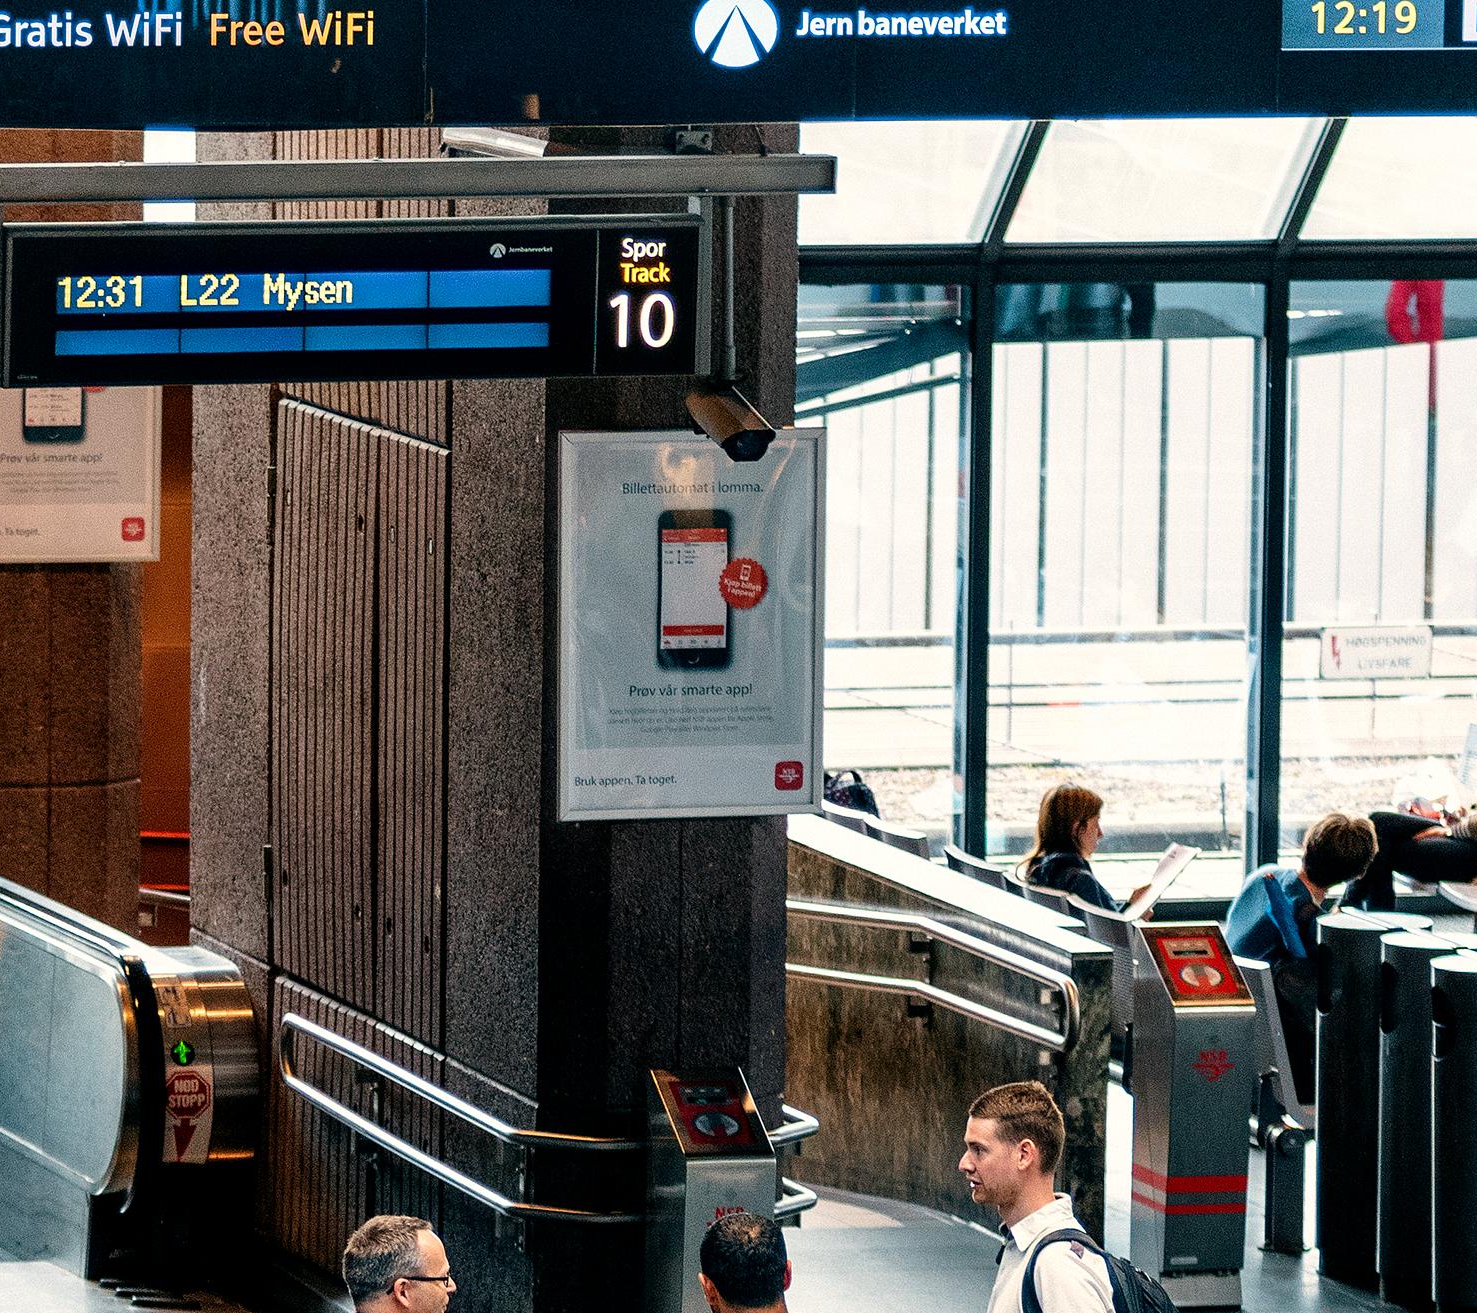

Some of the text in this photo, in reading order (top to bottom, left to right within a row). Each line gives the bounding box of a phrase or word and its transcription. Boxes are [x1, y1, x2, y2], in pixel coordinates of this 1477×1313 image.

[106, 12, 182, 46] WiFi
[211, 11, 373, 45] Free WiFi
[797, 9, 1006, 36] Jernbaneverket
[622, 238, 666, 262] Spor
[621, 260, 670, 283] Track
[57, 273, 353, 311] 12:31 L22 Mysen
[610, 293, 674, 347] 10
[622, 481, 709, 495] Billettautomat
[717, 481, 763, 493] lomma.
[629, 683, 753, 700] Prøv vår smarte app!
[575, 774, 678, 789] Bruk appen. Ta toget.
[169, 1094, 205, 1108] STOPP
